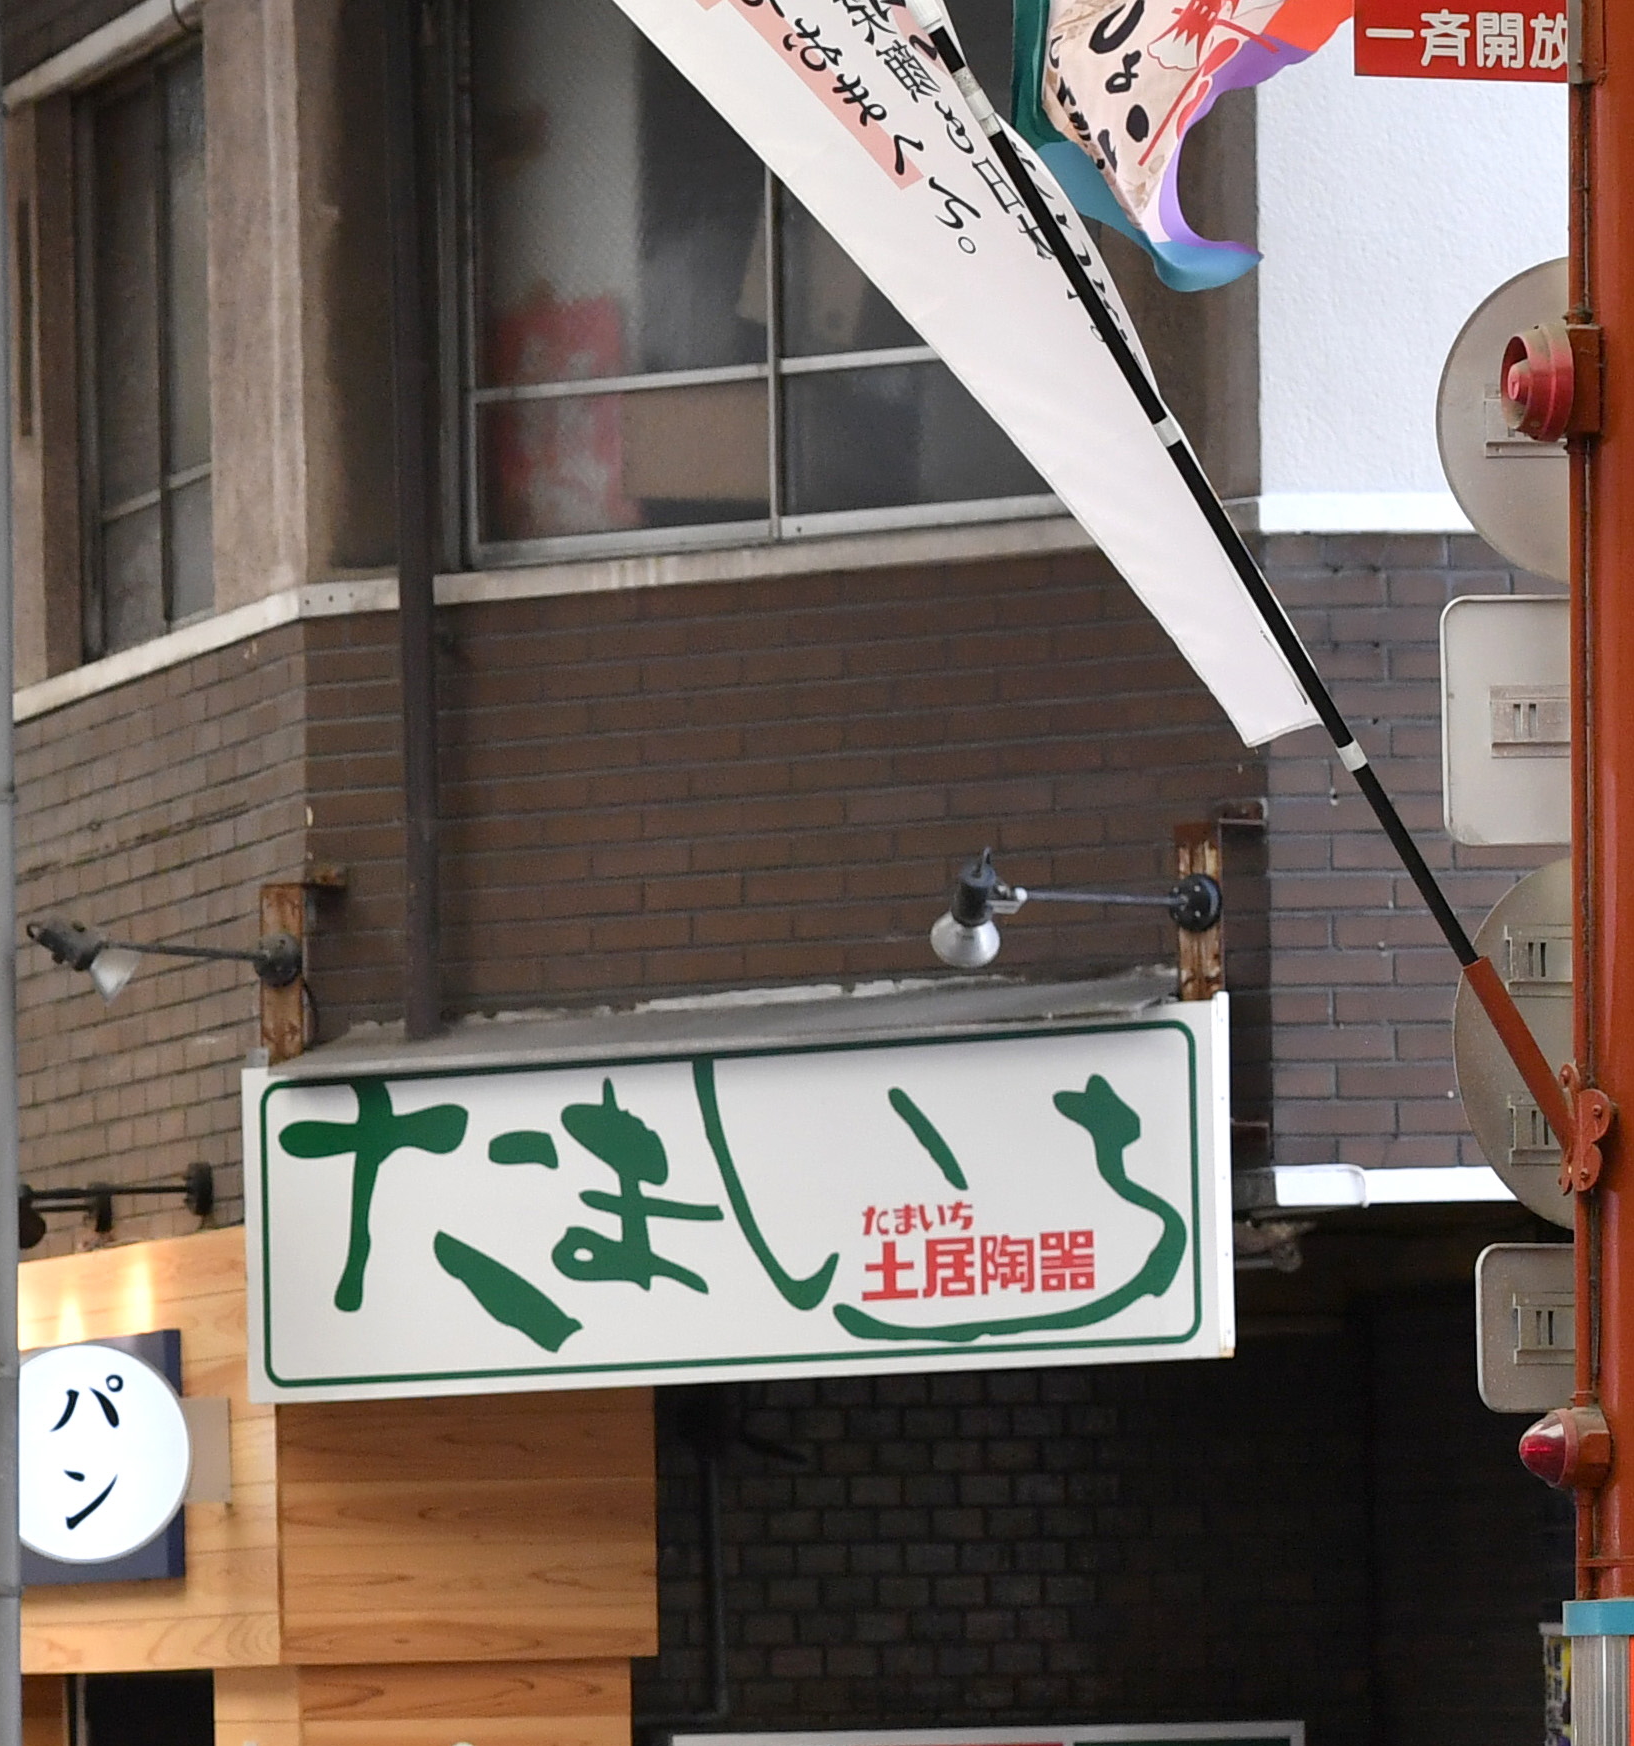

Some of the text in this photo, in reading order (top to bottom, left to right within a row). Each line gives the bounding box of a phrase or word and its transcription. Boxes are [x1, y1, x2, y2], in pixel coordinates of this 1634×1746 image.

[278, 1058, 1189, 1353] たまいち
[861, 1200, 975, 1236] たまいち
[861, 1229, 1096, 1303] 土居陶器
[51, 1373, 125, 1531] パン
